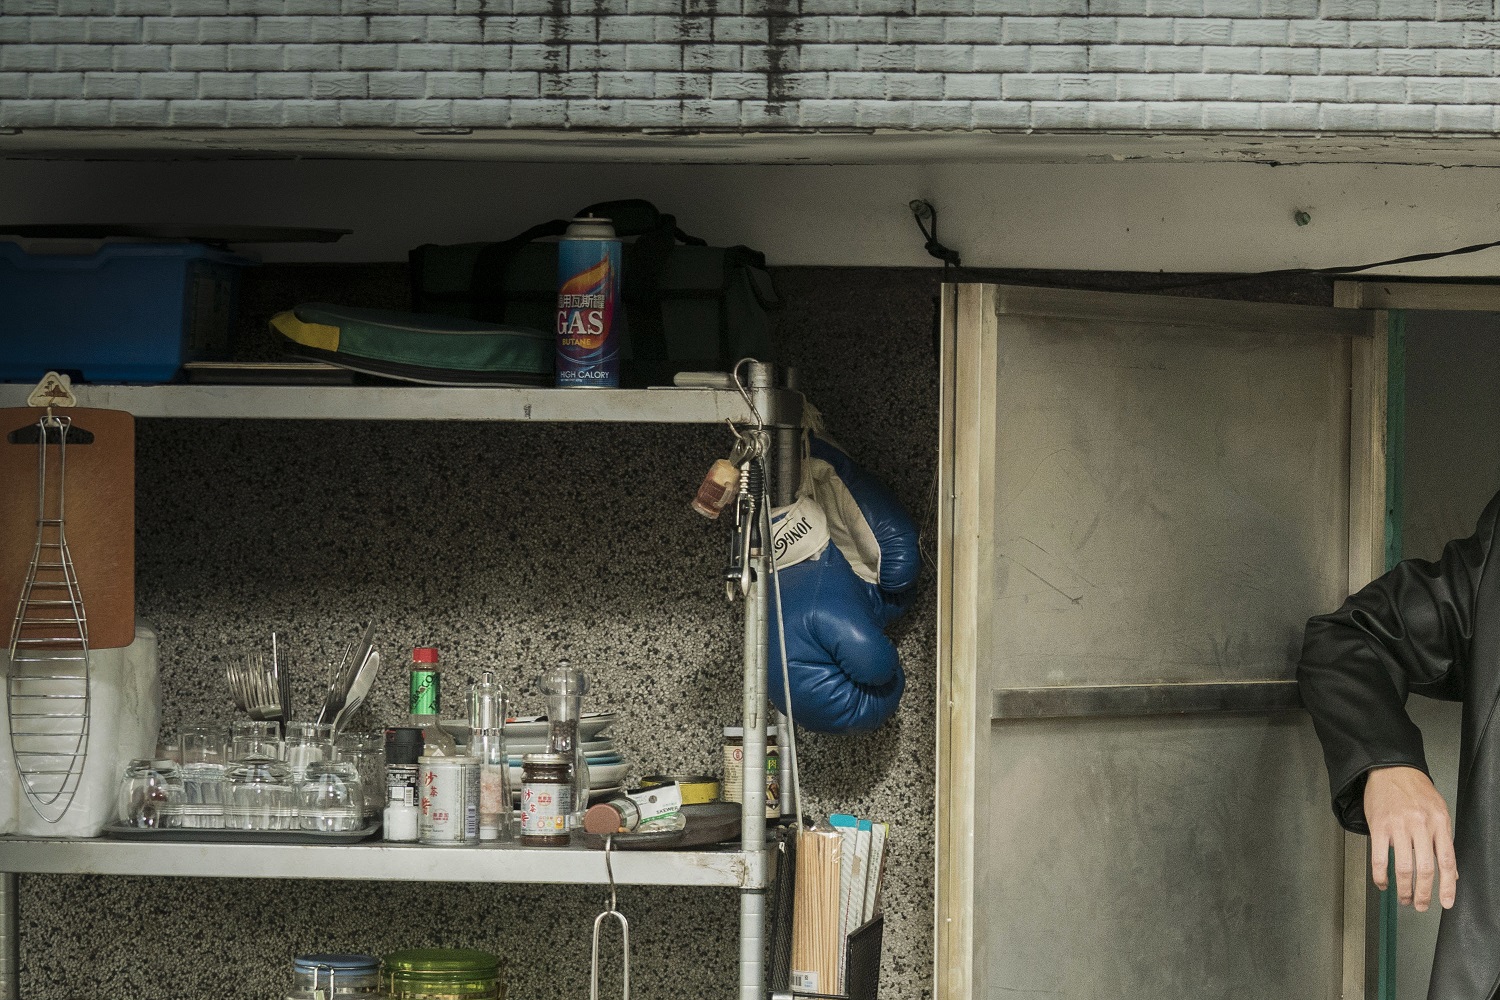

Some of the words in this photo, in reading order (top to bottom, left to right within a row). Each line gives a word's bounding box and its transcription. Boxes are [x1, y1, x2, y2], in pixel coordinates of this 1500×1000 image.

[557, 310, 604, 335] GAS
[562, 338, 592, 346] BUTANE
[578, 370, 610, 379] CALORY
